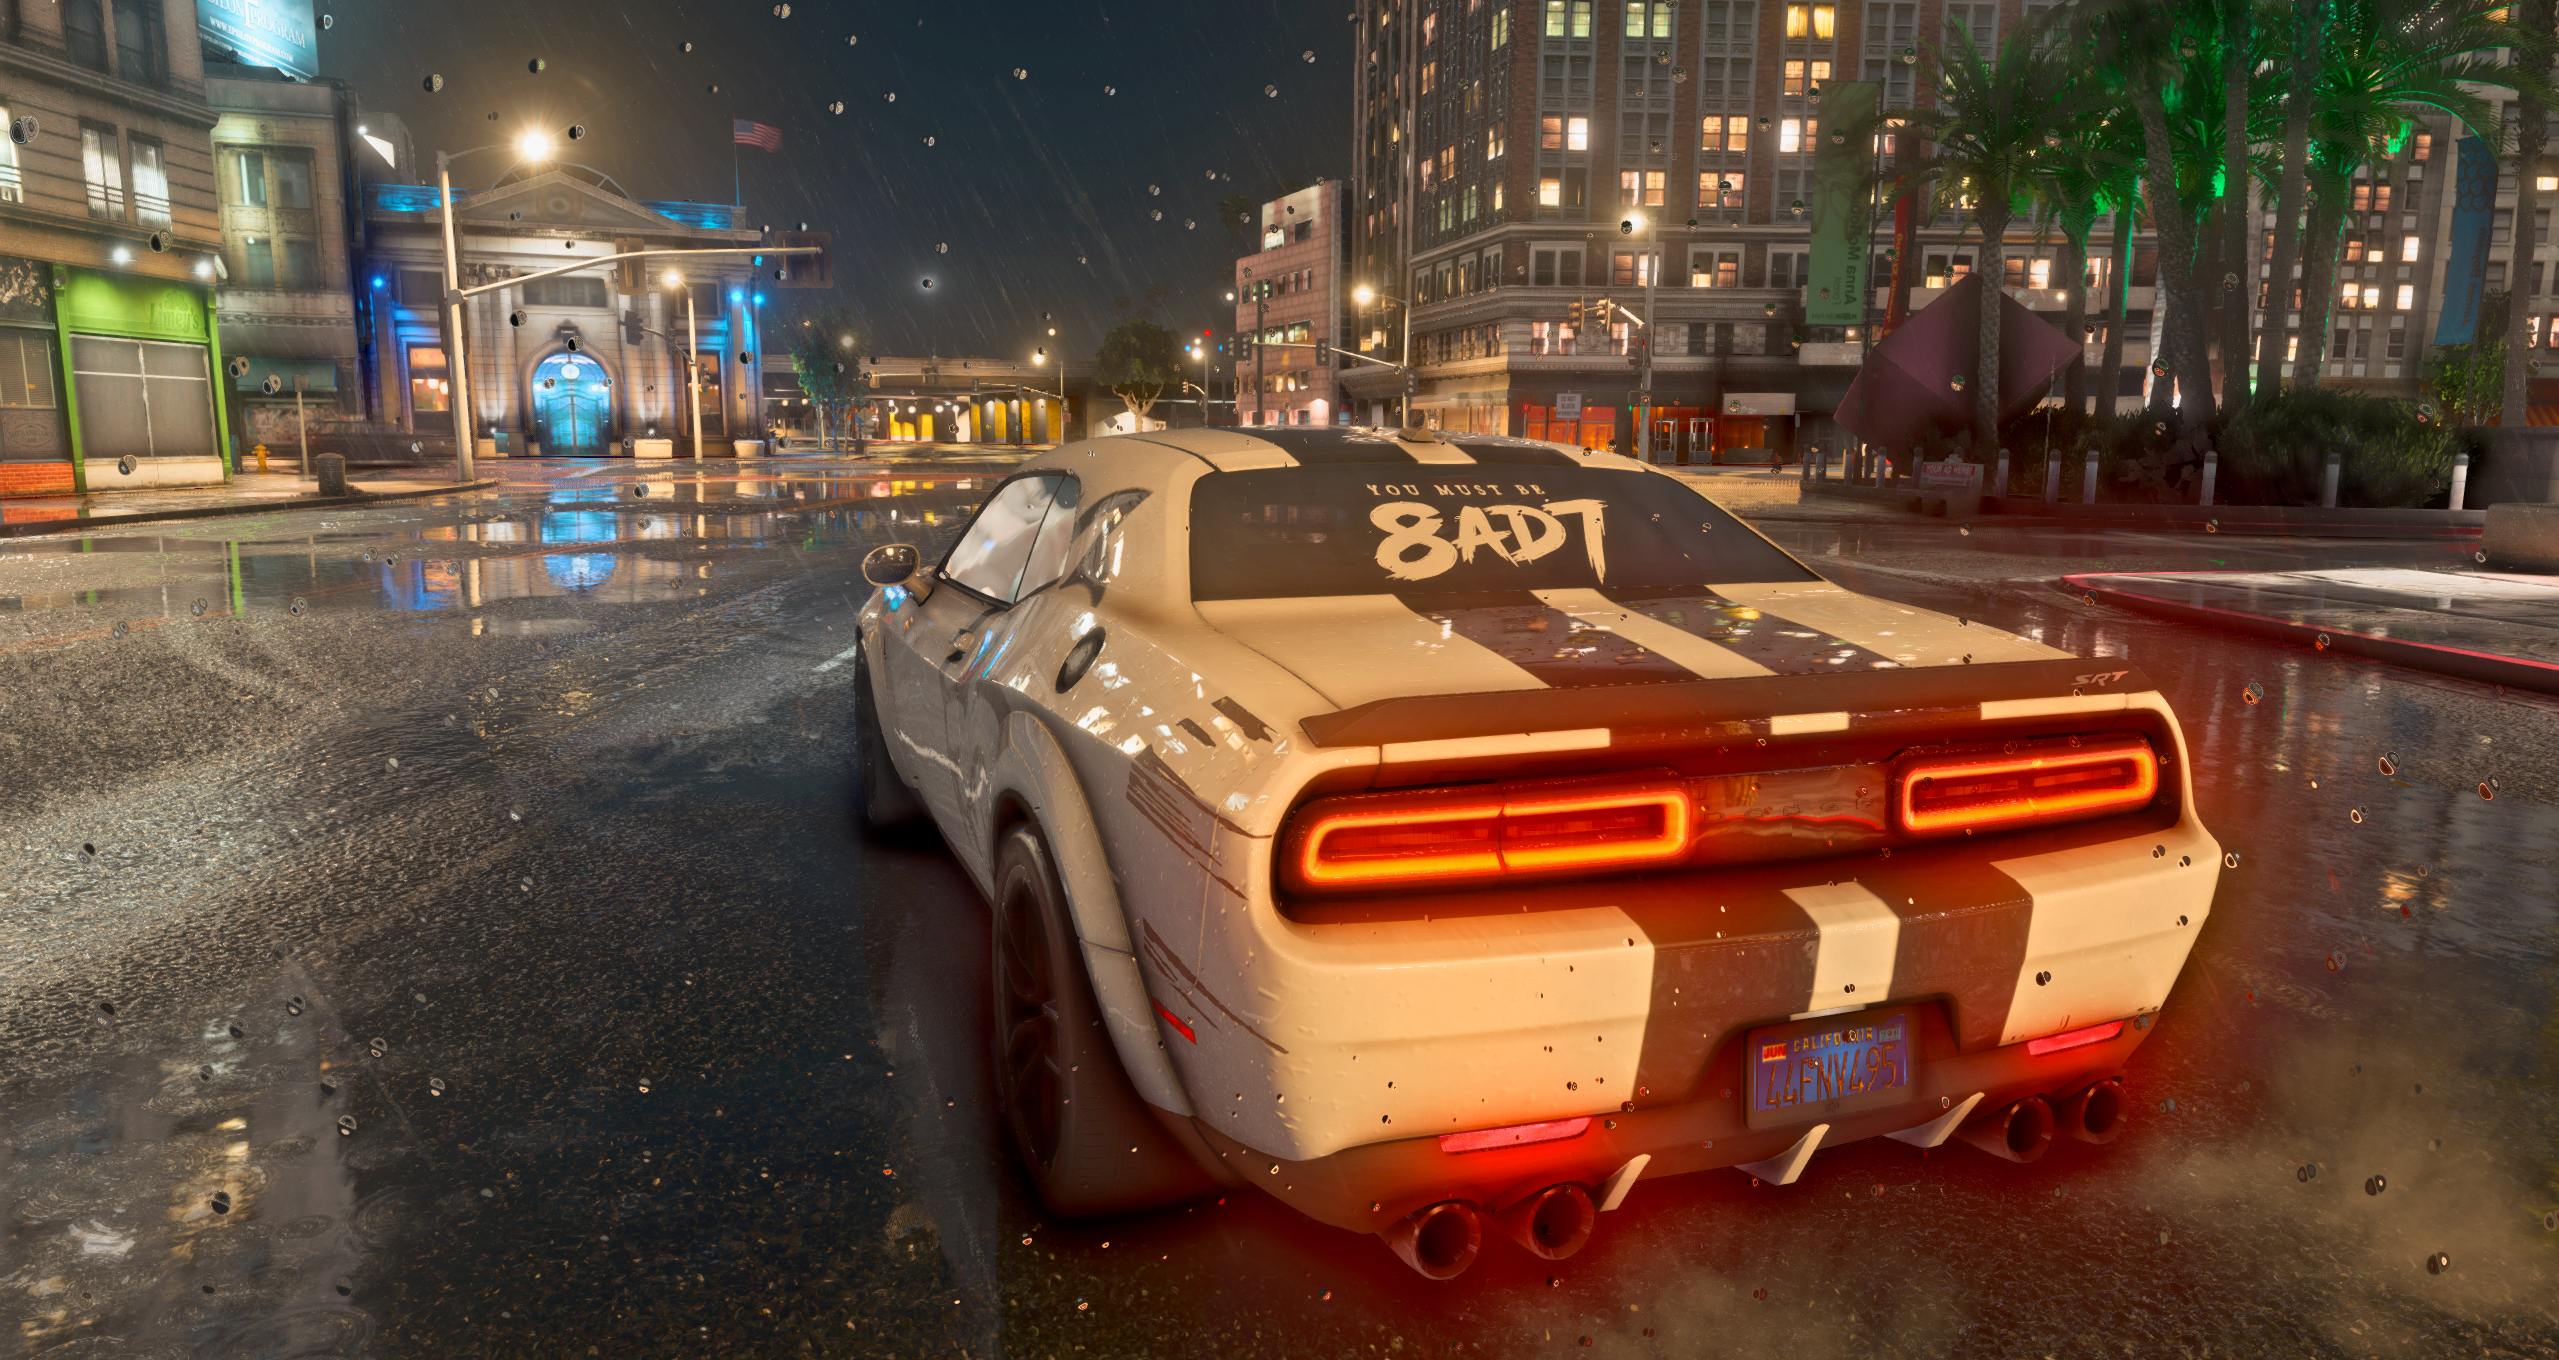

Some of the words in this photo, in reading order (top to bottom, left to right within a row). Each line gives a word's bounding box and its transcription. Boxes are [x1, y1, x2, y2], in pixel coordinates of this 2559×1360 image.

[209, 15, 294, 63] WWW.EPSILONPROGRAM.COM
[247, 7, 306, 49] PROGRAM
[149, 302, 199, 334] Limey's
[1926, 464, 1942, 473] YOUR
[1943, 465, 1952, 474] AD
[1952, 465, 1973, 475] HERE!
[1365, 483, 1420, 496] YOU
[1434, 484, 1503, 496] MUST
[1514, 484, 1546, 496] BE
[2069, 670, 2130, 687] SRT
[1763, 1044, 1787, 1059] JUN
[1765, 1044, 1897, 1108] 44FNV495
